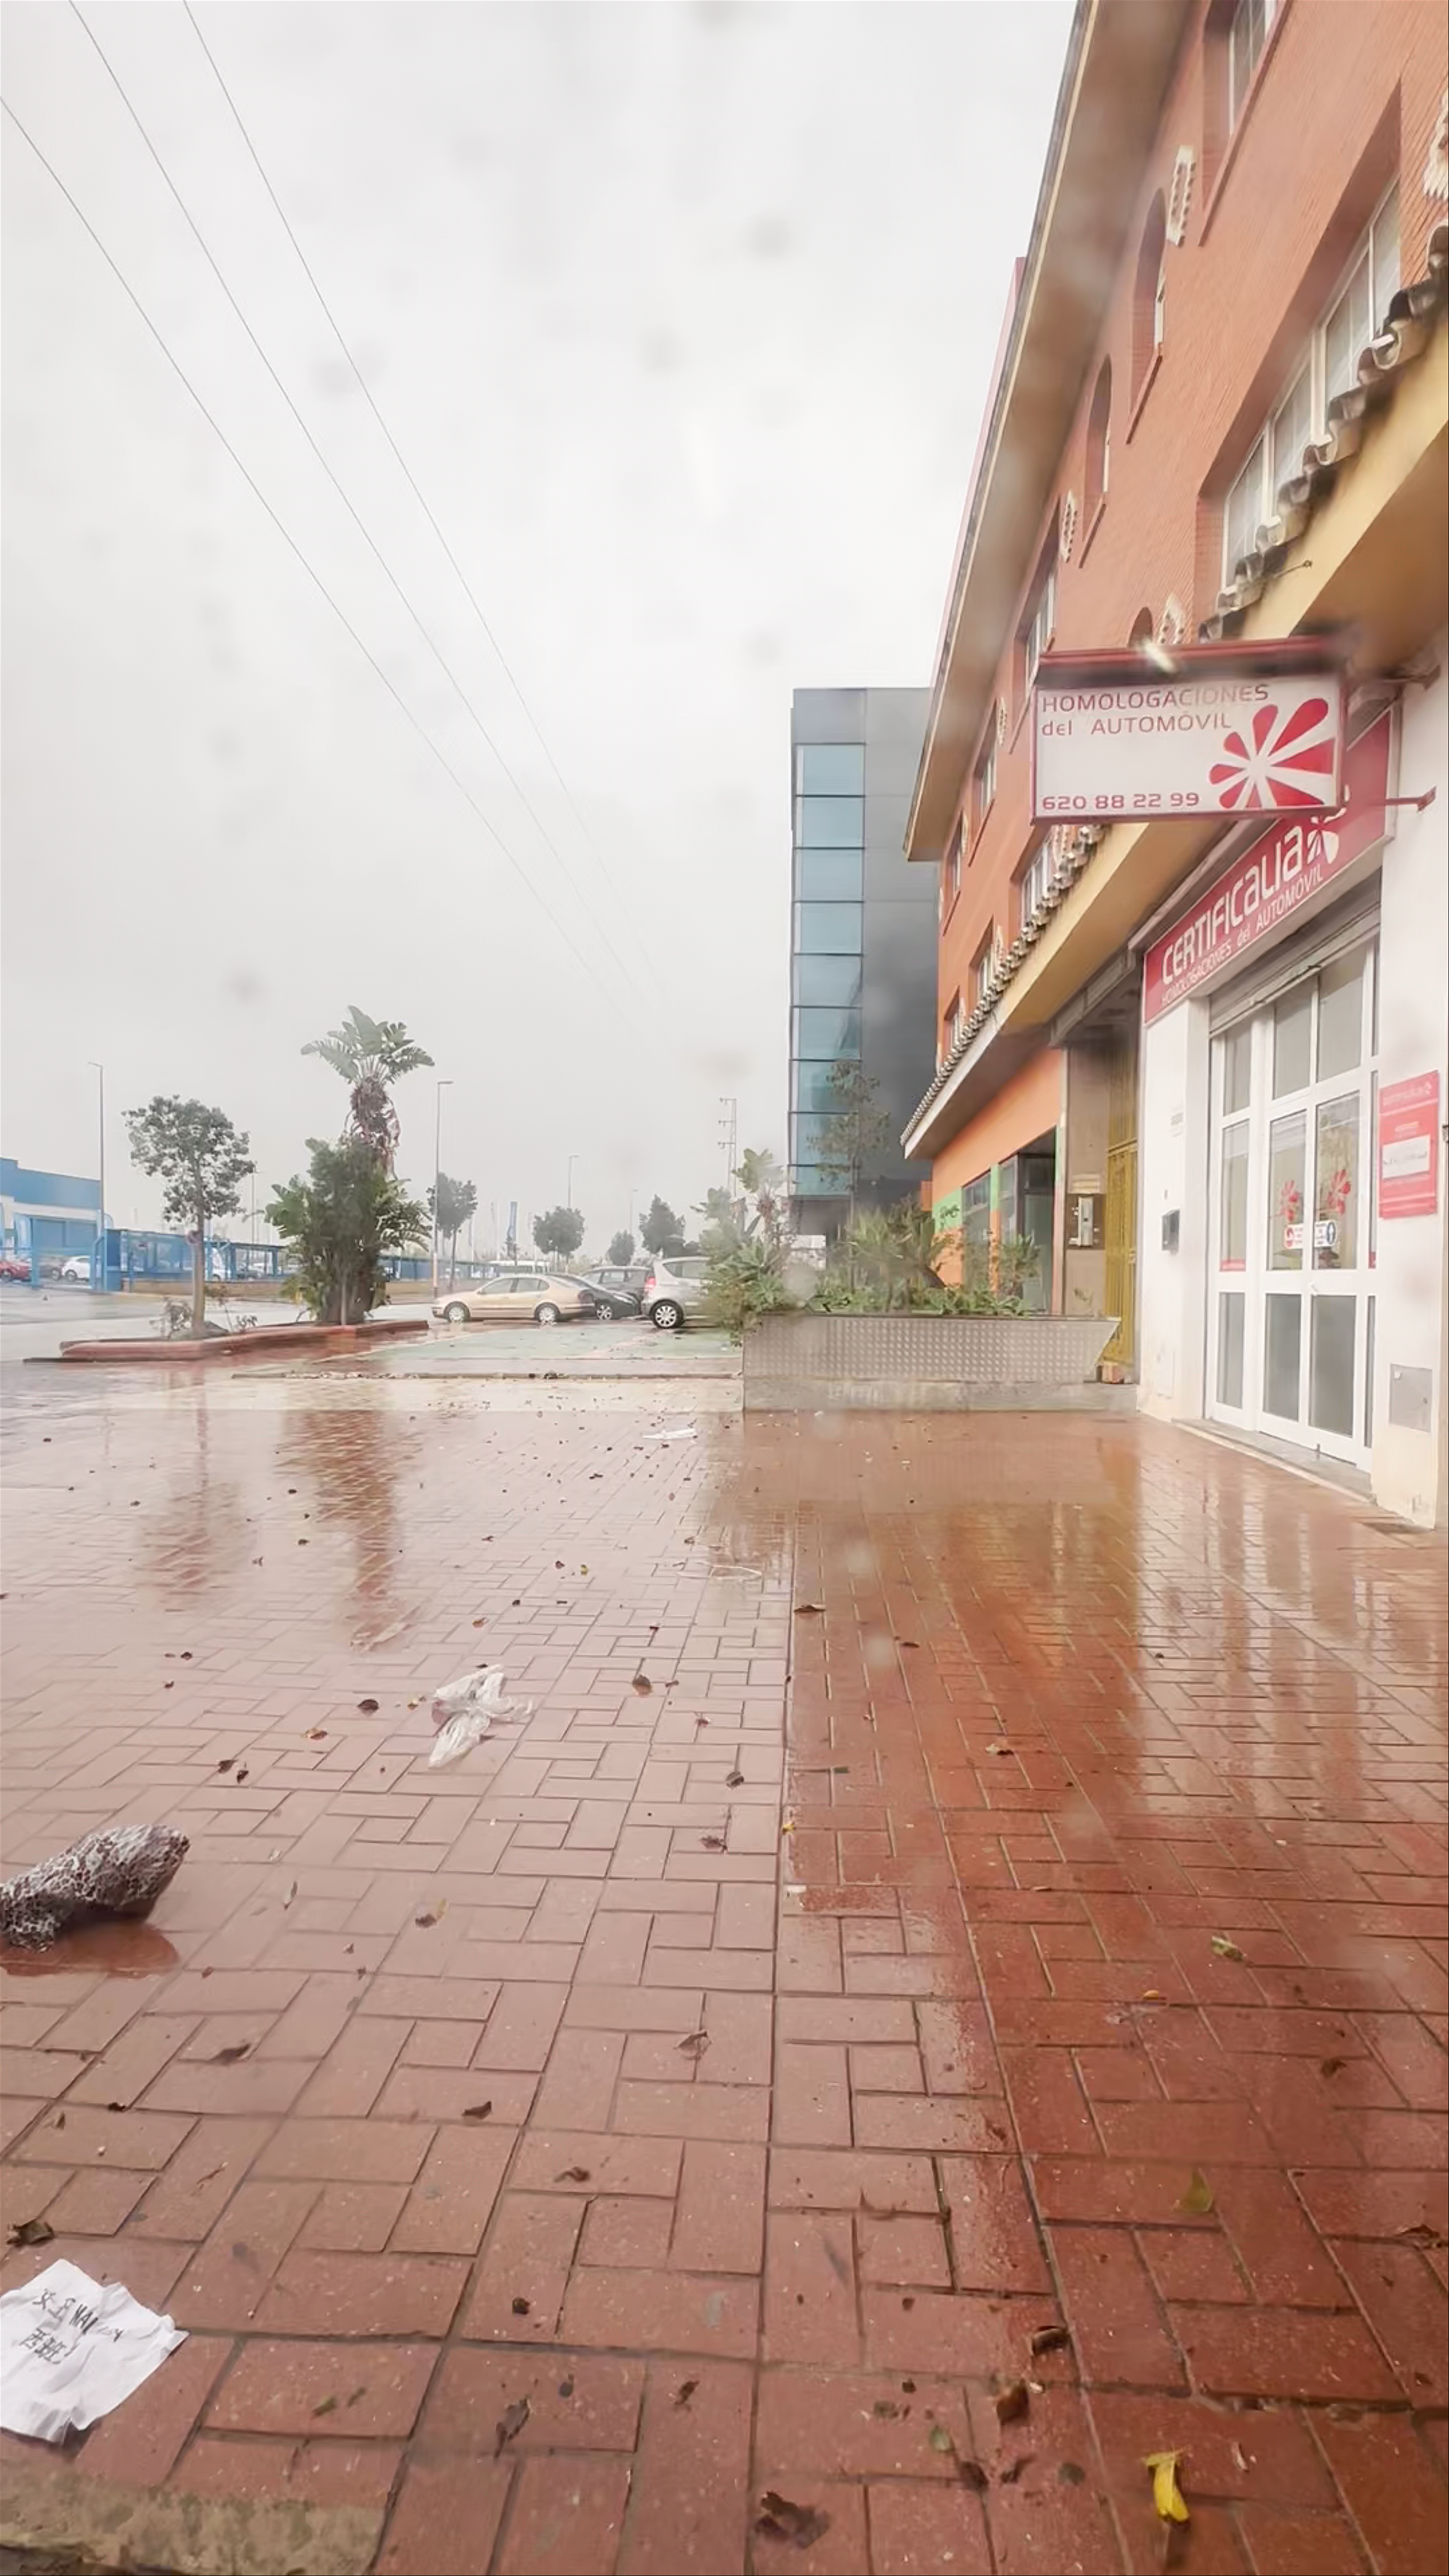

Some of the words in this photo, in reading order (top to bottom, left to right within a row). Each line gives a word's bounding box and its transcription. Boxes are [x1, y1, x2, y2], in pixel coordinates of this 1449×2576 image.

[1043, 684, 1269, 712] HOMOLOGACIONES
[1041, 720, 1072, 735] del
[1042, 796, 1087, 810] 620
[1095, 795, 1124, 809] 88
[1133, 793, 1161, 807] 22
[1170, 792, 1200, 807] 99
